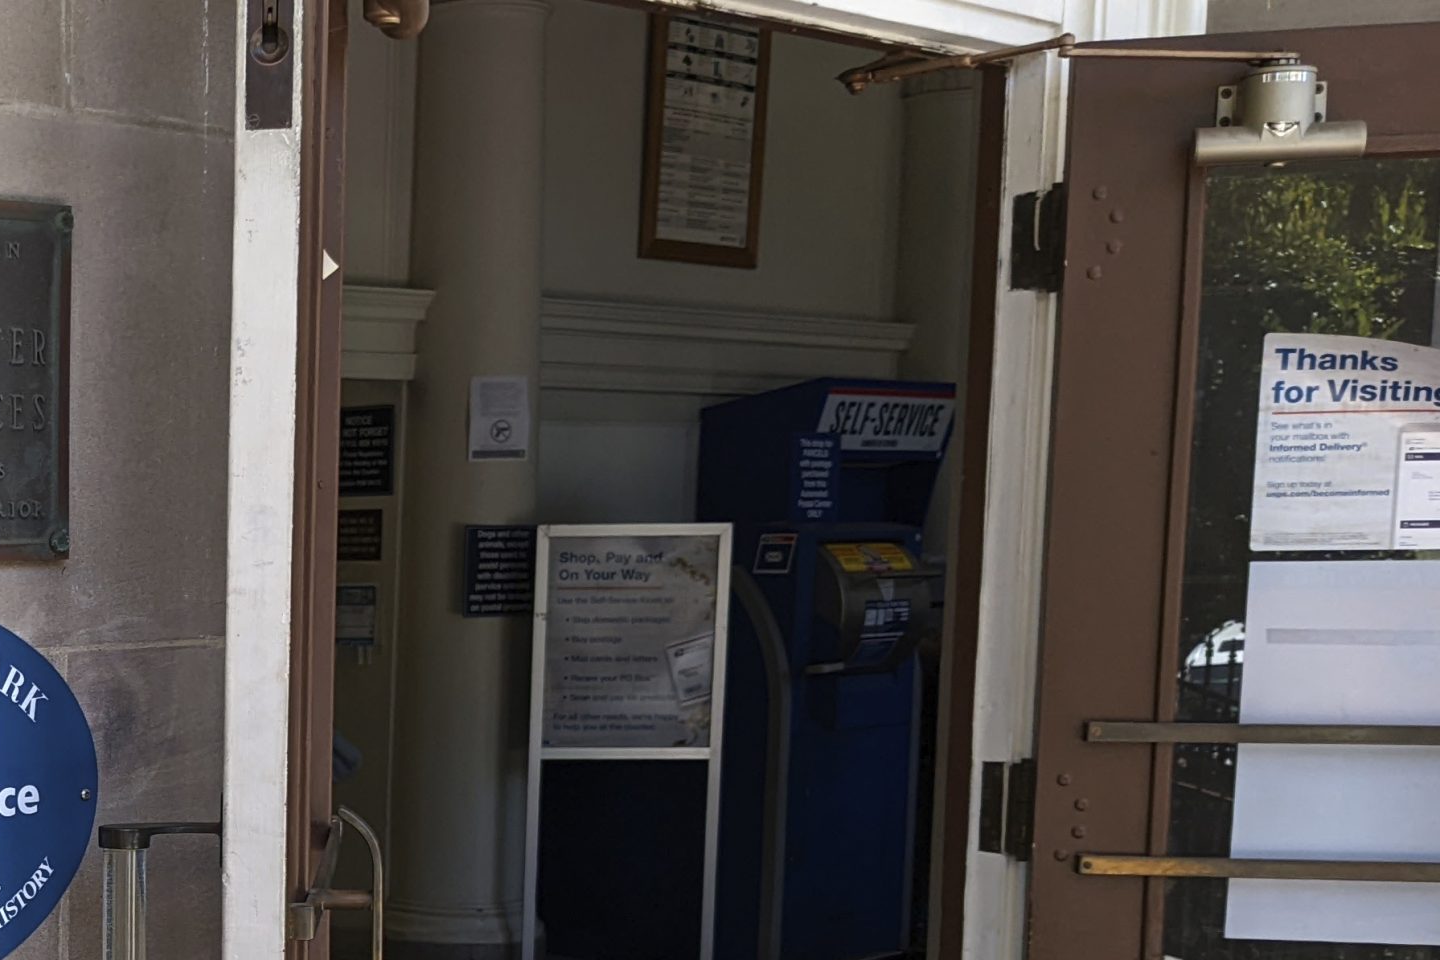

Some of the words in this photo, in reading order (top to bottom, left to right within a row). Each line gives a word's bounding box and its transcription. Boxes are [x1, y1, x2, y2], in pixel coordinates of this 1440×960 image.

[1274, 347, 1399, 372] Thanks
[1271, 380, 1319, 404] for
[829, 400, 946, 437] SELF-SERVICE
[1324, 421, 1333, 430] in
[1293, 432, 1329, 442] mailbox
[1331, 432, 1350, 441] with
[1269, 443, 1317, 453] Informed
[559, 551, 601, 565] Shop,
[606, 552, 631, 565] Pay
[559, 569, 579, 581] On
[584, 569, 617, 581] Your
[620, 569, 651, 583] Way
